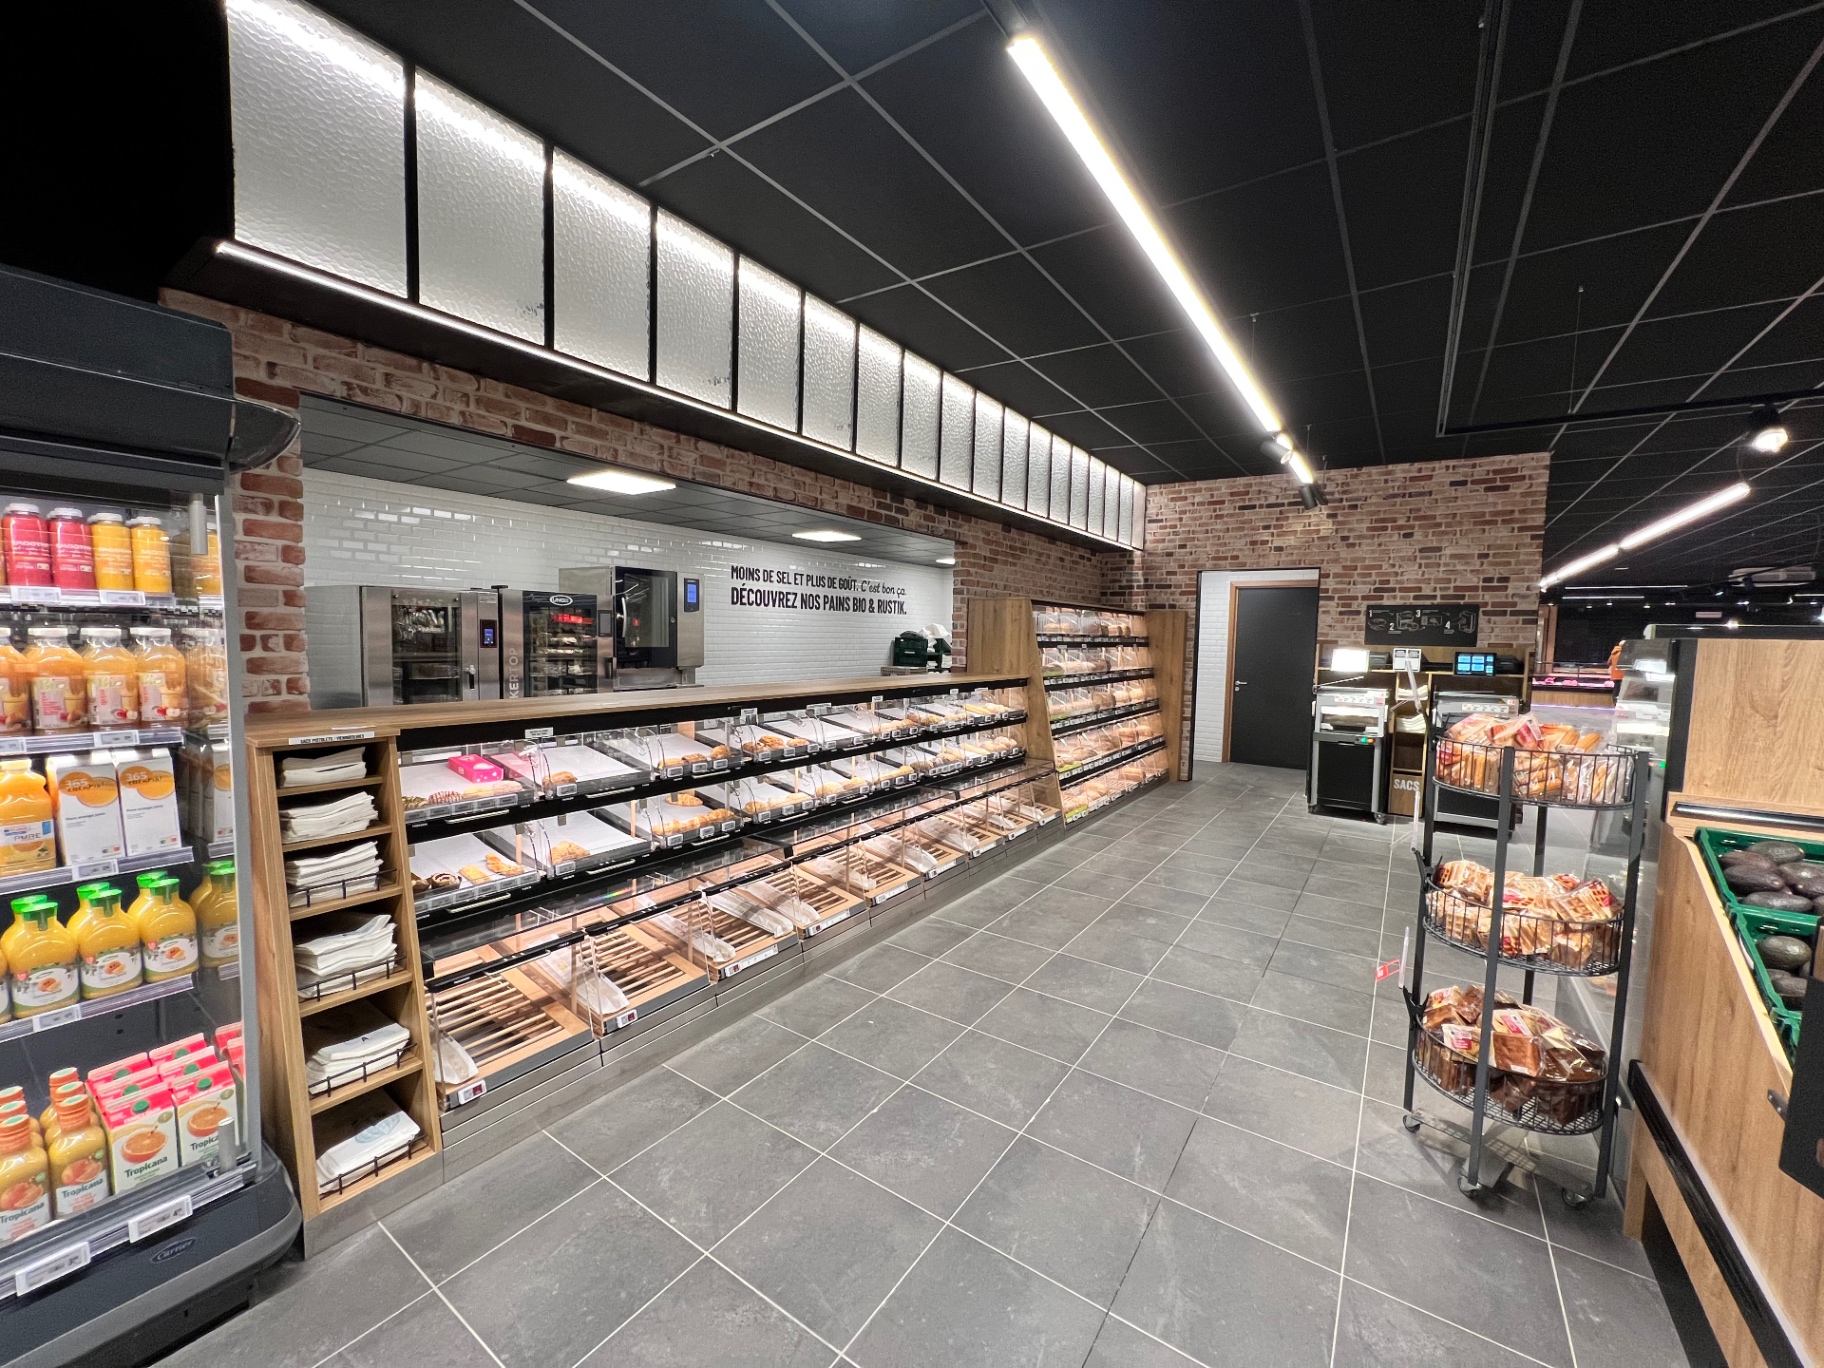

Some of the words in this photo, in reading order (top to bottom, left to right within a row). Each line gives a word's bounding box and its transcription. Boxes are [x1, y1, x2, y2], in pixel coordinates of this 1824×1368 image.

[731, 565, 760, 582] MOINS
[763, 569, 774, 583] DE
[776, 570, 792, 585] SEL
[794, 572, 804, 586] ET
[806, 574, 826, 588] PLUS
[827, 576, 838, 589] DE
[838, 576, 859, 591] GOÛT.
[882, 582, 895, 595] bon
[731, 582, 798, 608] DÉCOUVREZ
[800, 593, 821, 610] NOS
[823, 594, 851, 612] PAINS
[852, 597, 867, 613] BIO
[868, 597, 876, 613] &
[877, 599, 907, 615] RUSTIK.
[1368, 609, 1374, 618] 1
[1415, 609, 1422, 618] 3
[1388, 622, 1395, 631] 2
[1444, 620, 1451, 630] 4
[66, 778, 89, 789] 365
[126, 771, 148, 781] 365
[1393, 778, 1420, 791] SACS
[189, 1135, 219, 1151] Tropica
[124, 1156, 168, 1178] Tropicana
[62, 1178, 104, 1198] Tropicana
[0, 1202, 45, 1223] Tropicana
